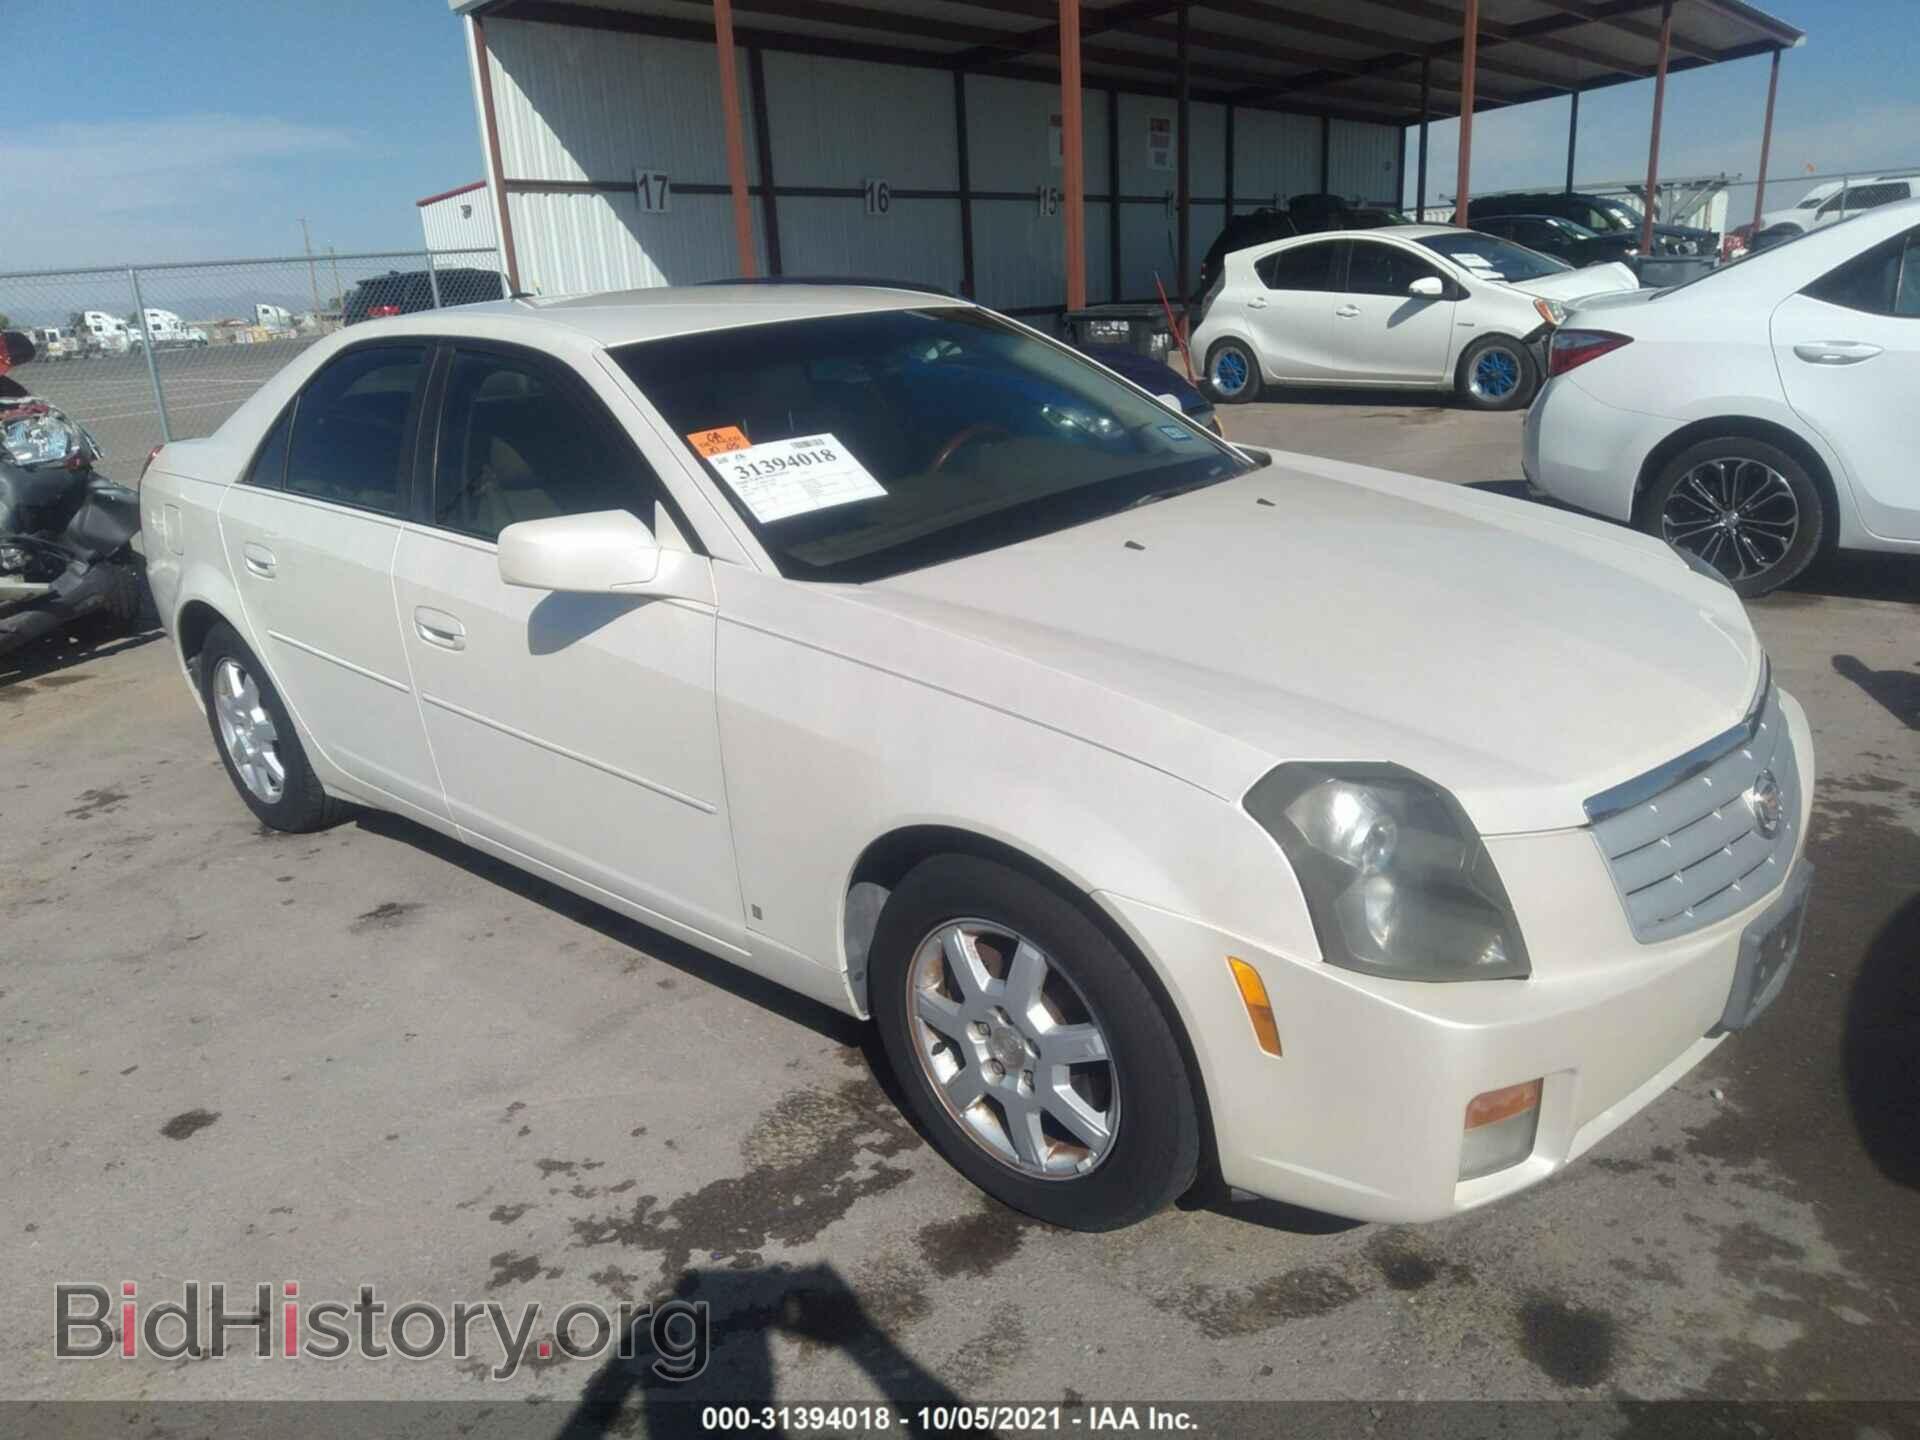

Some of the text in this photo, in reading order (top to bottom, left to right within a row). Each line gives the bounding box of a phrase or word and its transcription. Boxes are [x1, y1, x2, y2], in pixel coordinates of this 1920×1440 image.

[638, 174, 668, 209] 17
[868, 182, 889, 212] 16
[1040, 186, 1057, 215] 15
[735, 449, 836, 480] 31394018
